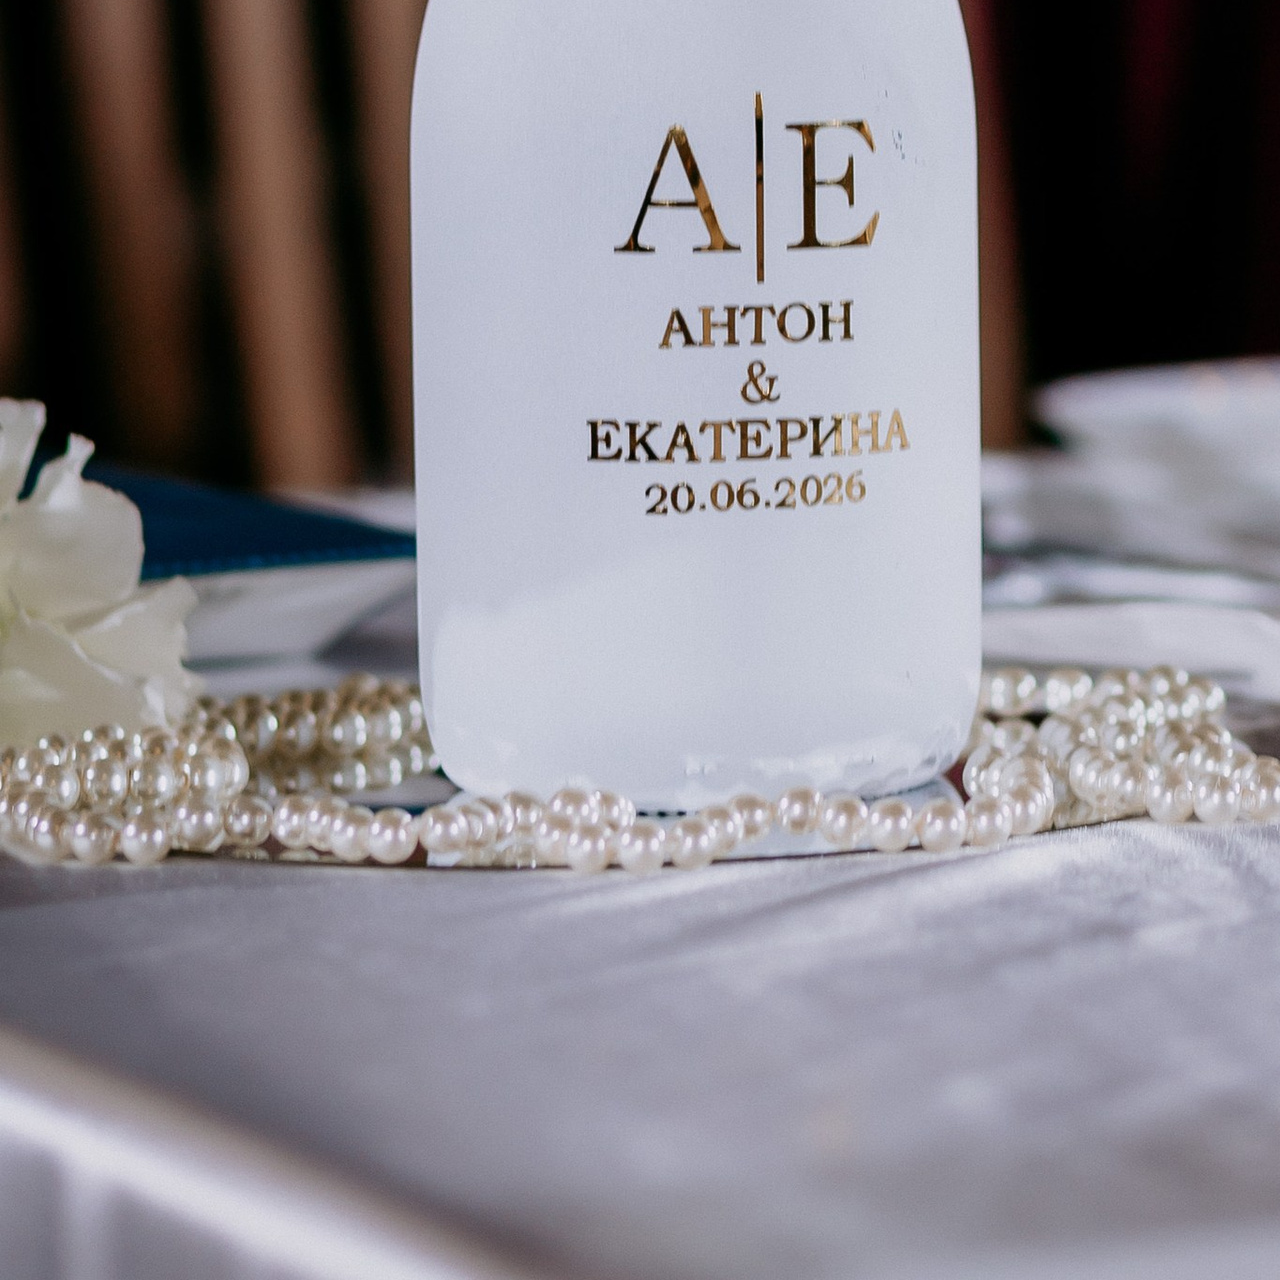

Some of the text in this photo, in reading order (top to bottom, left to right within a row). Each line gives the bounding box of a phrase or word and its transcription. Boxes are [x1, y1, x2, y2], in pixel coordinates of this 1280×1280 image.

[658, 299, 855, 349] АНТОН
[739, 359, 781, 405] &
[586, 408, 911, 464] ЕКАТЕРИНА
[644, 469, 867, 516] 20.06.2026
